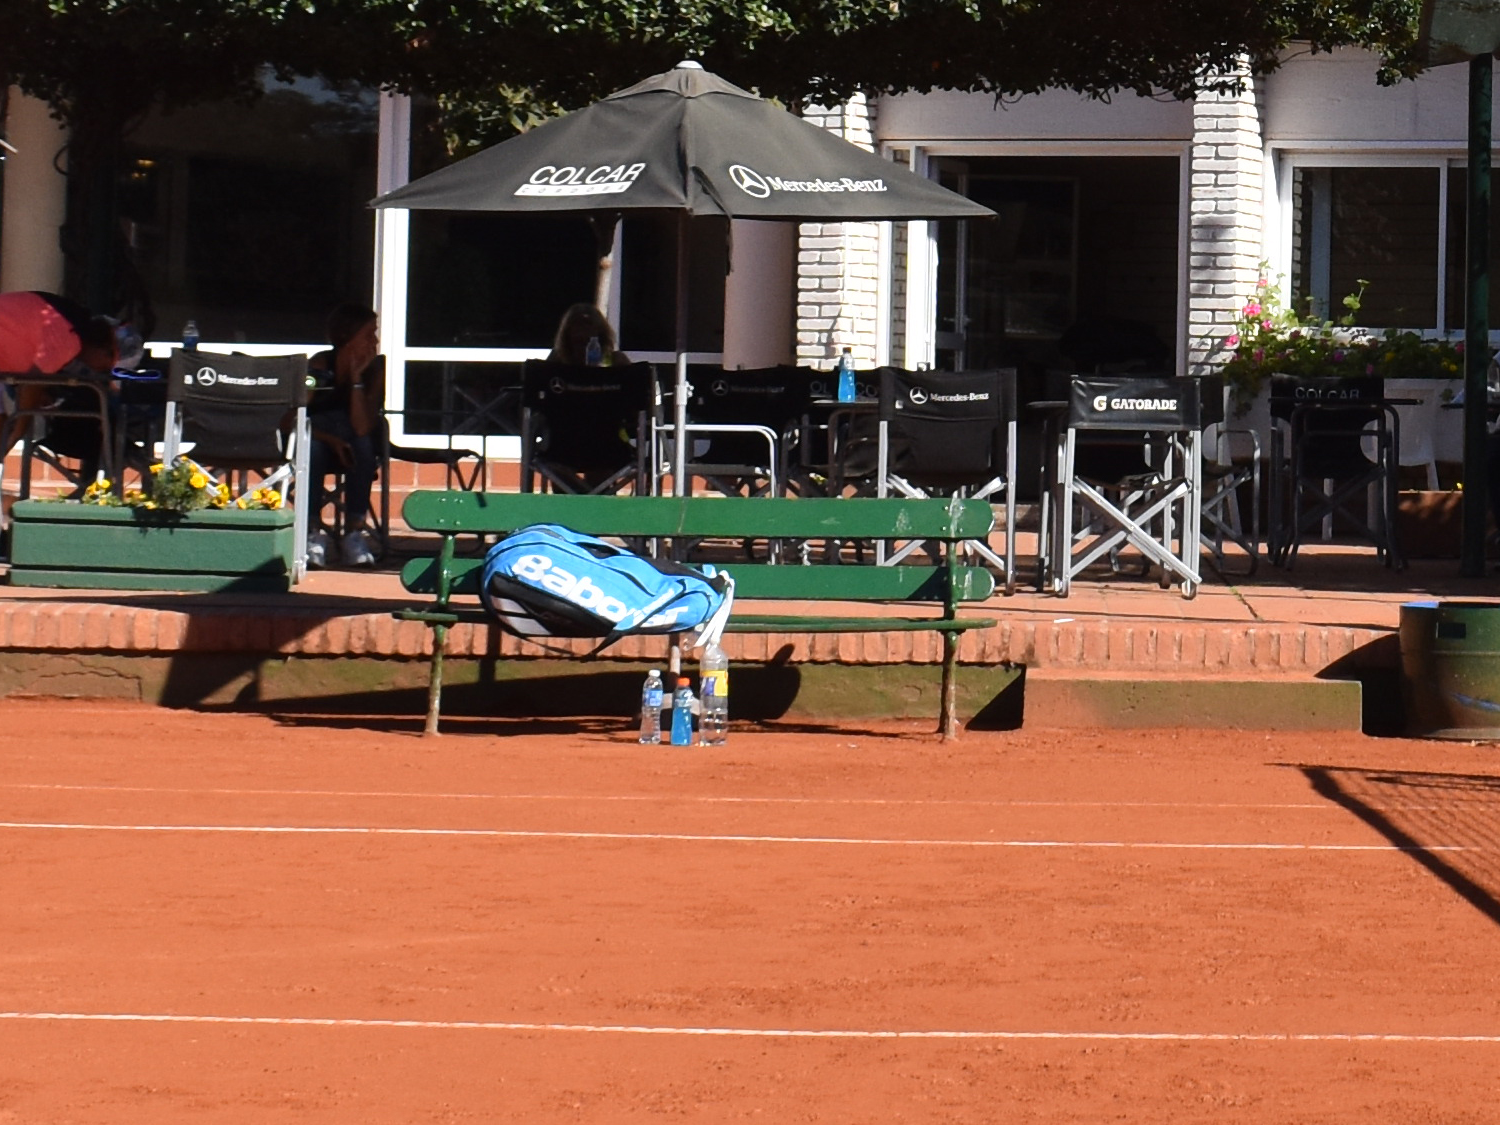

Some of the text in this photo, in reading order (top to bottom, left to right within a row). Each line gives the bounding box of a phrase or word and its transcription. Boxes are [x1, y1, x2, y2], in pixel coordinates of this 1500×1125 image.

[529, 162, 647, 185] COLCAR
[765, 176, 888, 192] Mercedes-Benz
[929, 392, 990, 402] Mercedes-Benz
[1110, 398, 1178, 410] GATORADE
